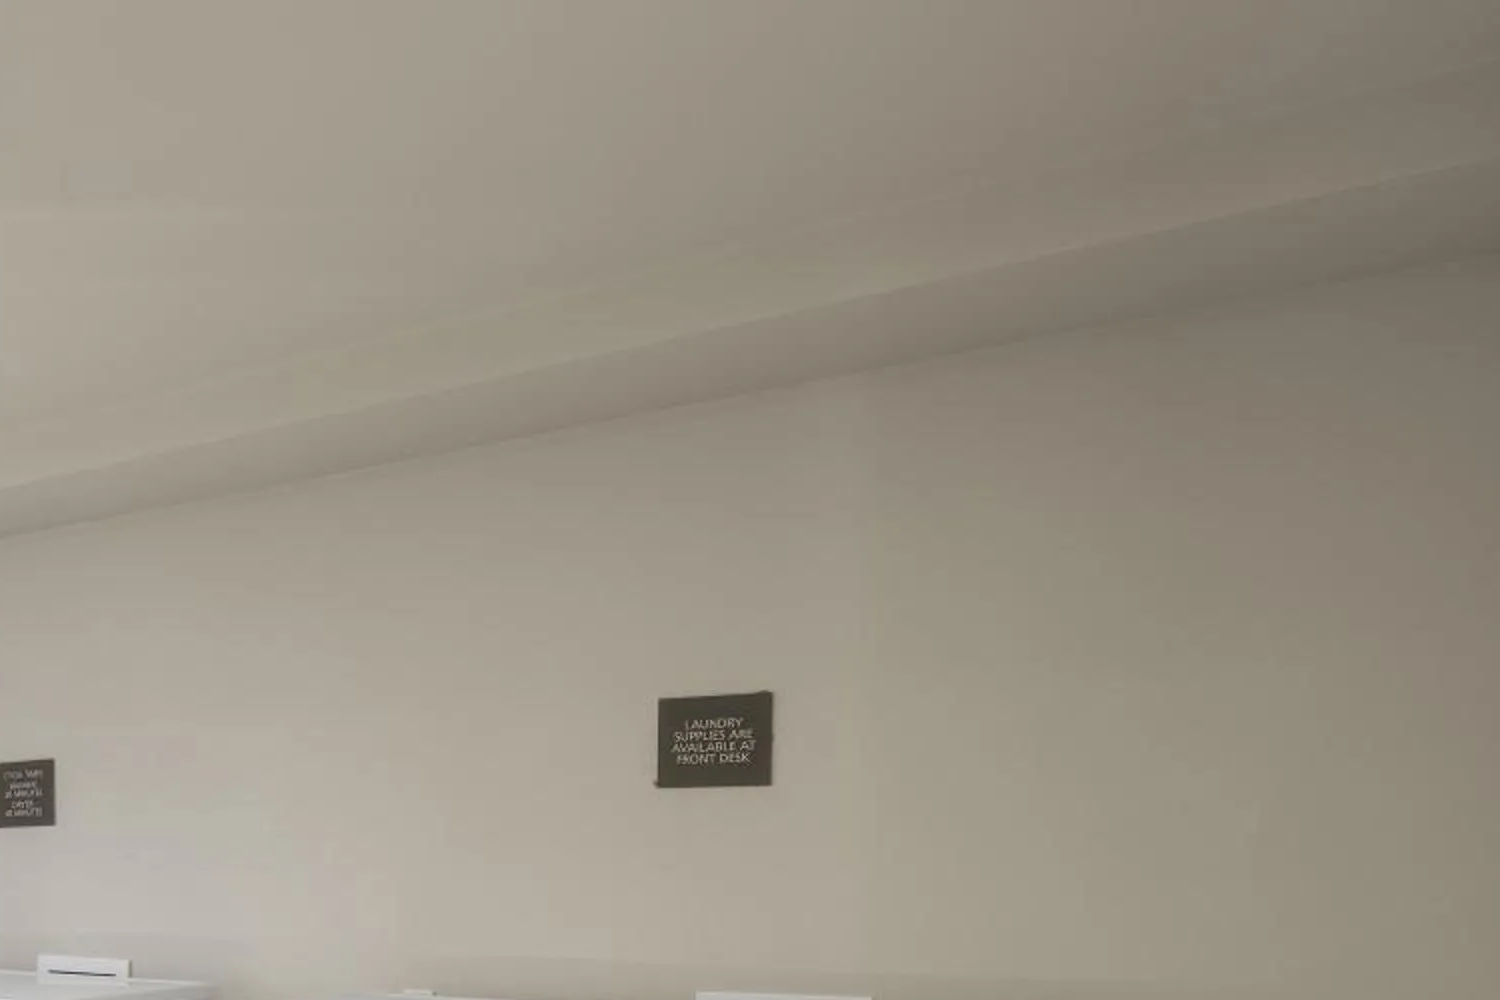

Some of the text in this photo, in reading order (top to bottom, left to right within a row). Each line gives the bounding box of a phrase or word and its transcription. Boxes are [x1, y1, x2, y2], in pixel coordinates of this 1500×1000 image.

[685, 718, 743, 730] LAUNDRY
[674, 728, 754, 742] SUPPLIES ARE
[671, 739, 757, 753] AVAILABLE AT
[676, 751, 751, 765] FRONT DESK
